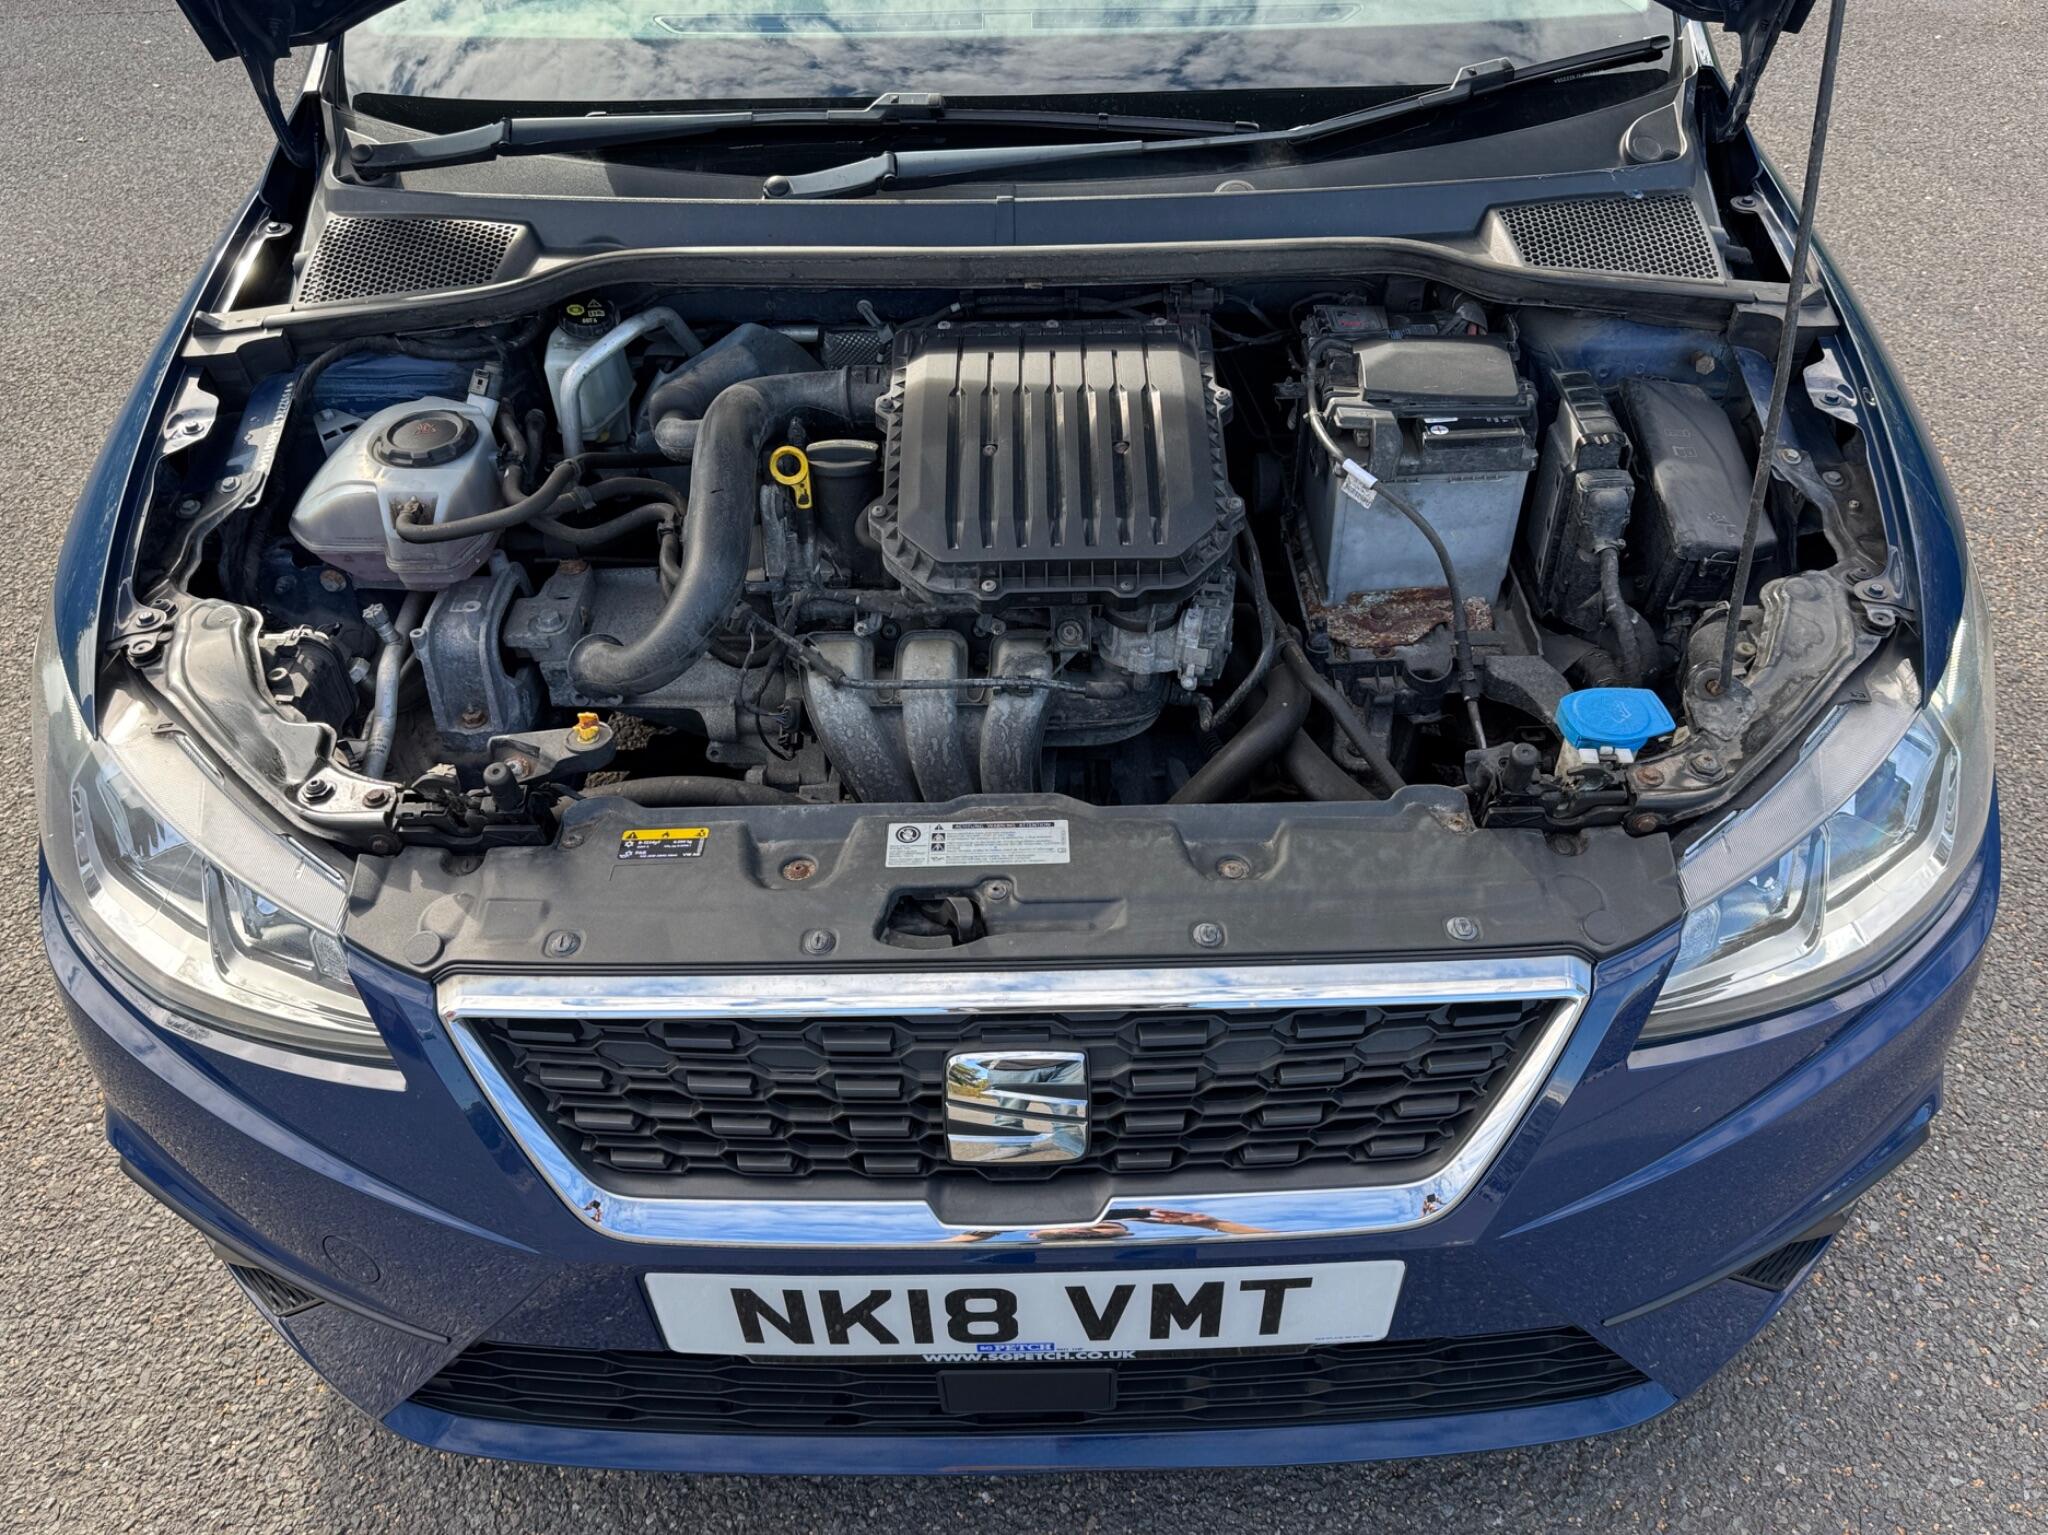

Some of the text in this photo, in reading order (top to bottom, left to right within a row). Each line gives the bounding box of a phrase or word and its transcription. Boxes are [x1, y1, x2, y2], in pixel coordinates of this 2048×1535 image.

[730, 1277, 1313, 1345] NK18 VMT
[995, 1343, 1054, 1351] PETCH
